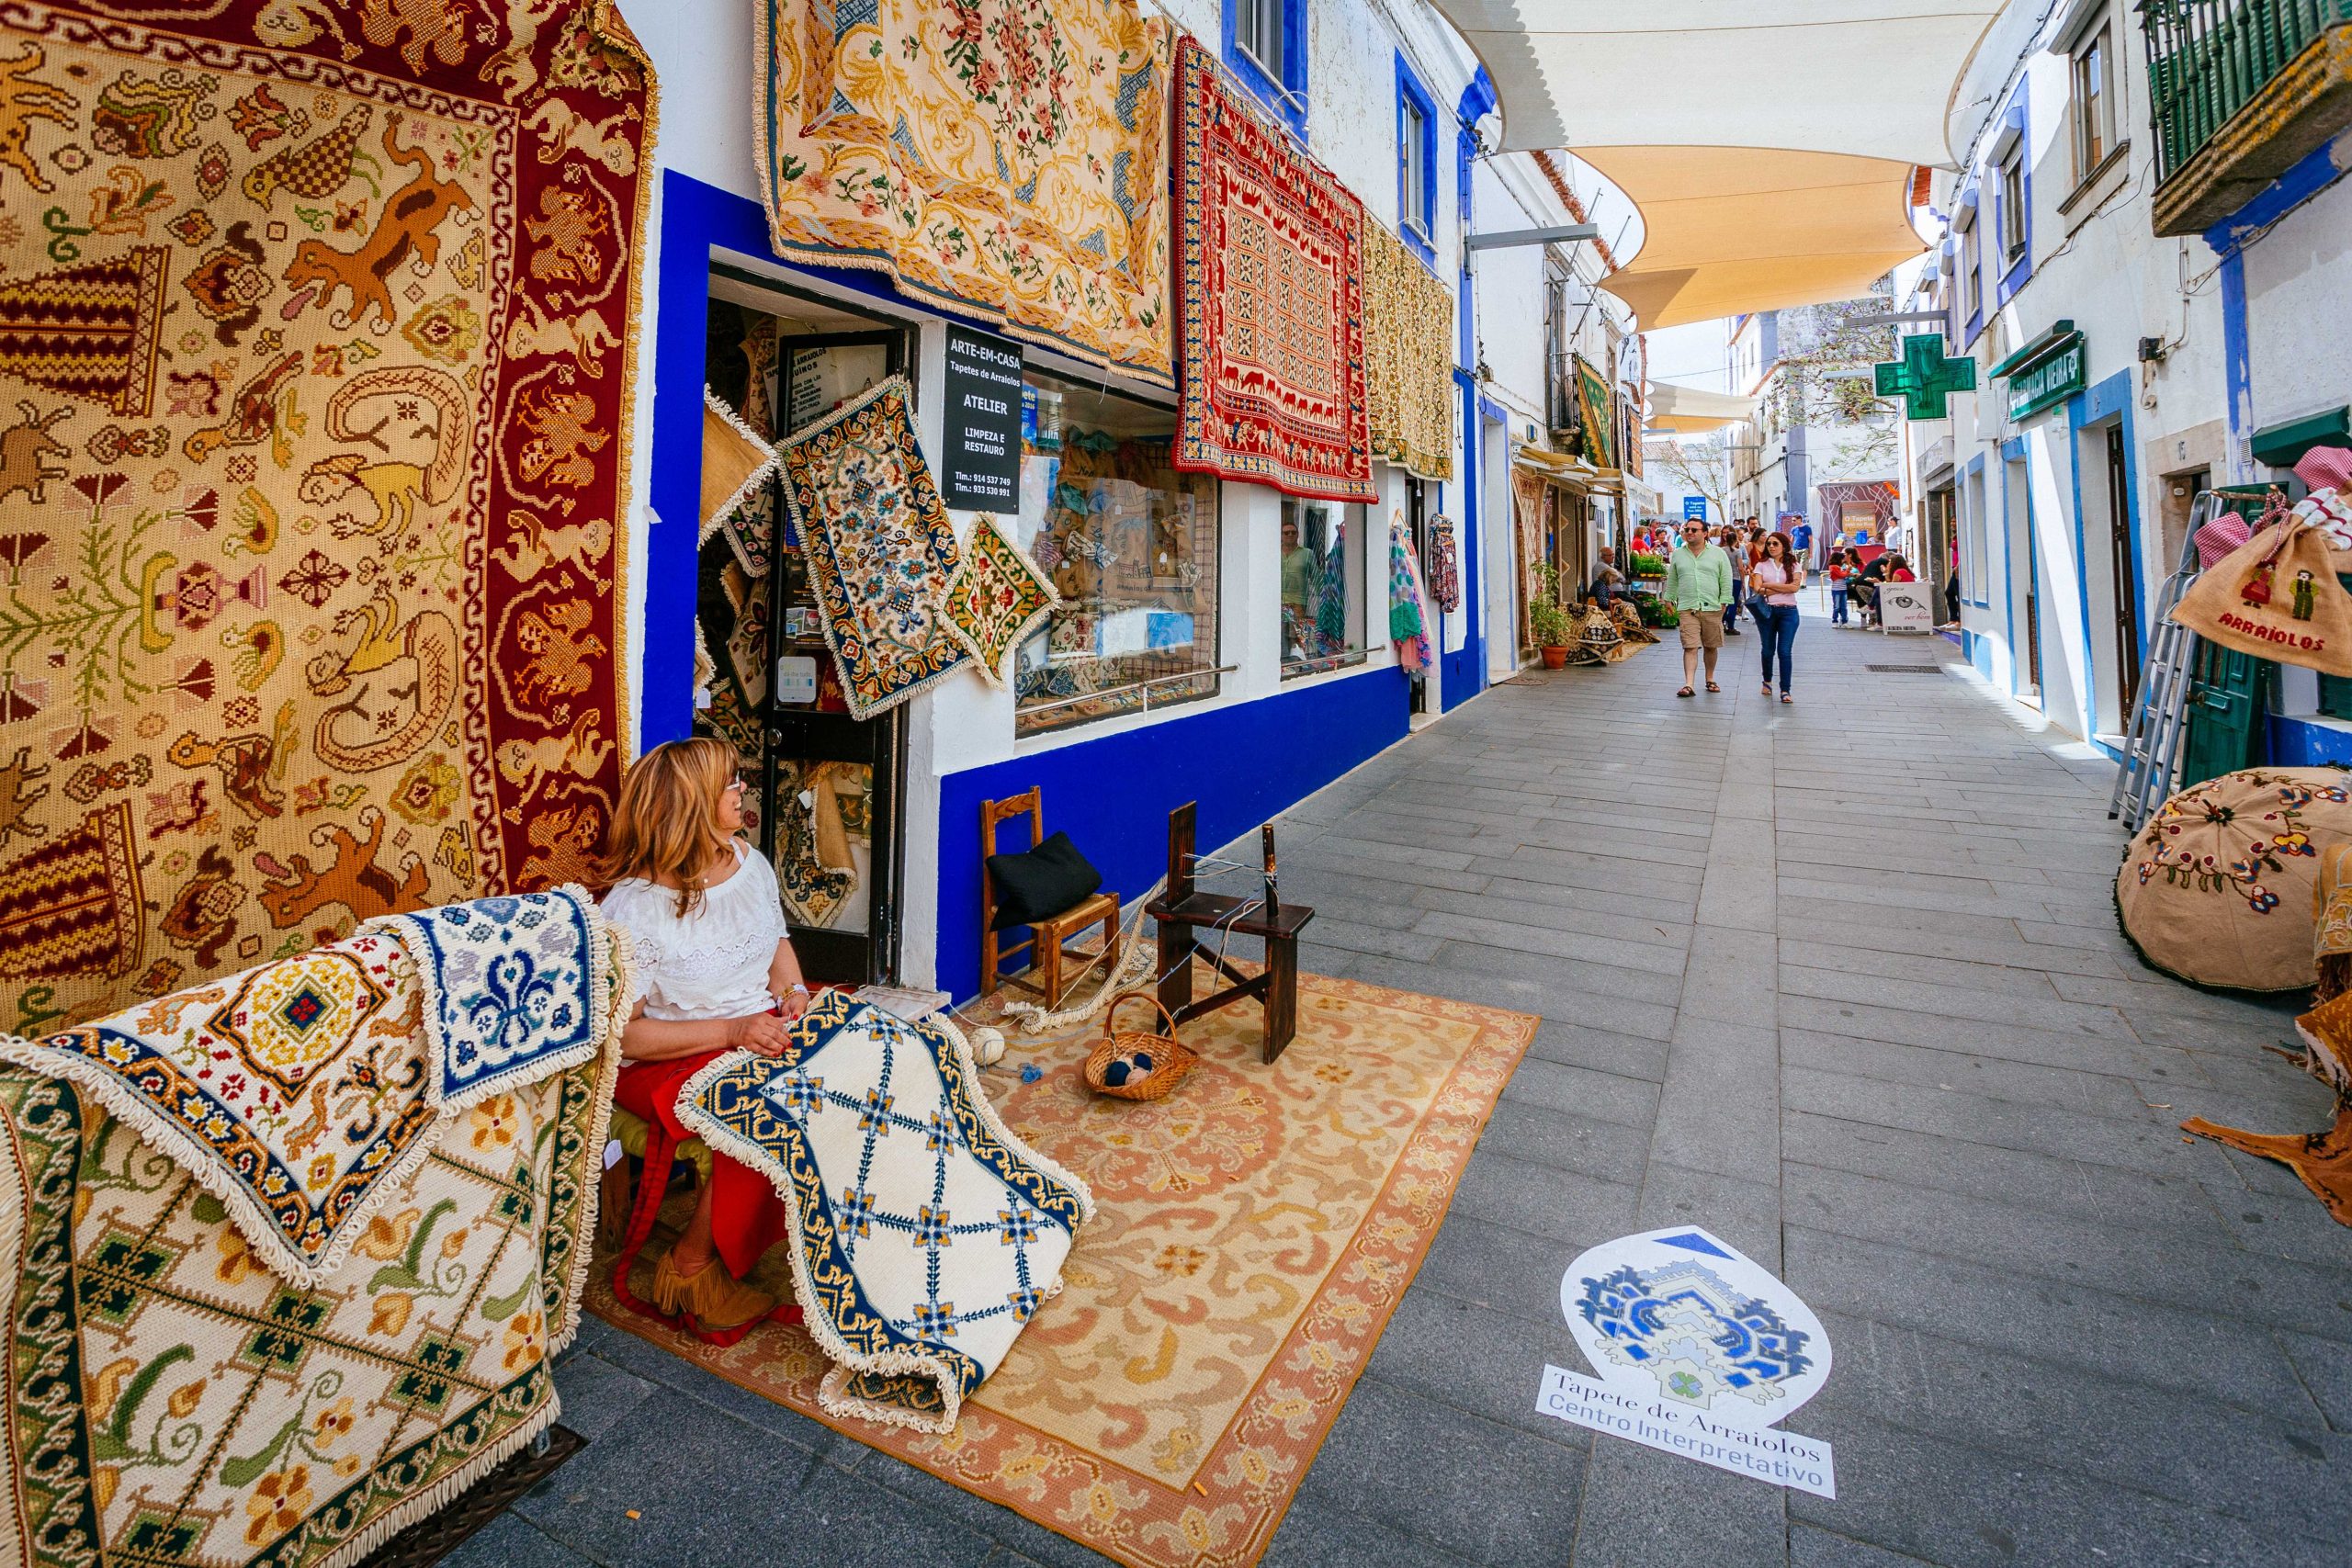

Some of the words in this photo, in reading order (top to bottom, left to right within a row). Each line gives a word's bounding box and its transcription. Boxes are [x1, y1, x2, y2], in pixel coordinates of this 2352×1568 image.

[950, 338, 1021, 370] ARTE-EM-CASA
[950, 360, 979, 377] Tapetes
[980, 368, 989, 379] de
[990, 371, 1021, 387] Arraiolos
[2046, 355, 2068, 392] VIEIRA
[964, 394, 1008, 416] ATELIER
[965, 426, 999, 443] LIMPEZA
[1000, 434, 1005, 444] E
[965, 441, 1005, 457] RESTAURO
[955, 482, 972, 492] Tlm.:
[973, 484, 986, 494] 933
[987, 486, 999, 495] 530
[999, 487, 1011, 497] 991
[956, 471, 972, 481] Tlm.:
[973, 473, 986, 483] 914
[987, 475, 999, 485] 537
[999, 477, 1011, 486] 749
[1554, 1372, 1639, 1412] Tapete
[1647, 1403, 1679, 1422] de
[1688, 1414, 1821, 1463] Arraiolos
[1549, 1393, 1631, 1431] Centro
[1638, 1419, 1824, 1487] Interpretativo
